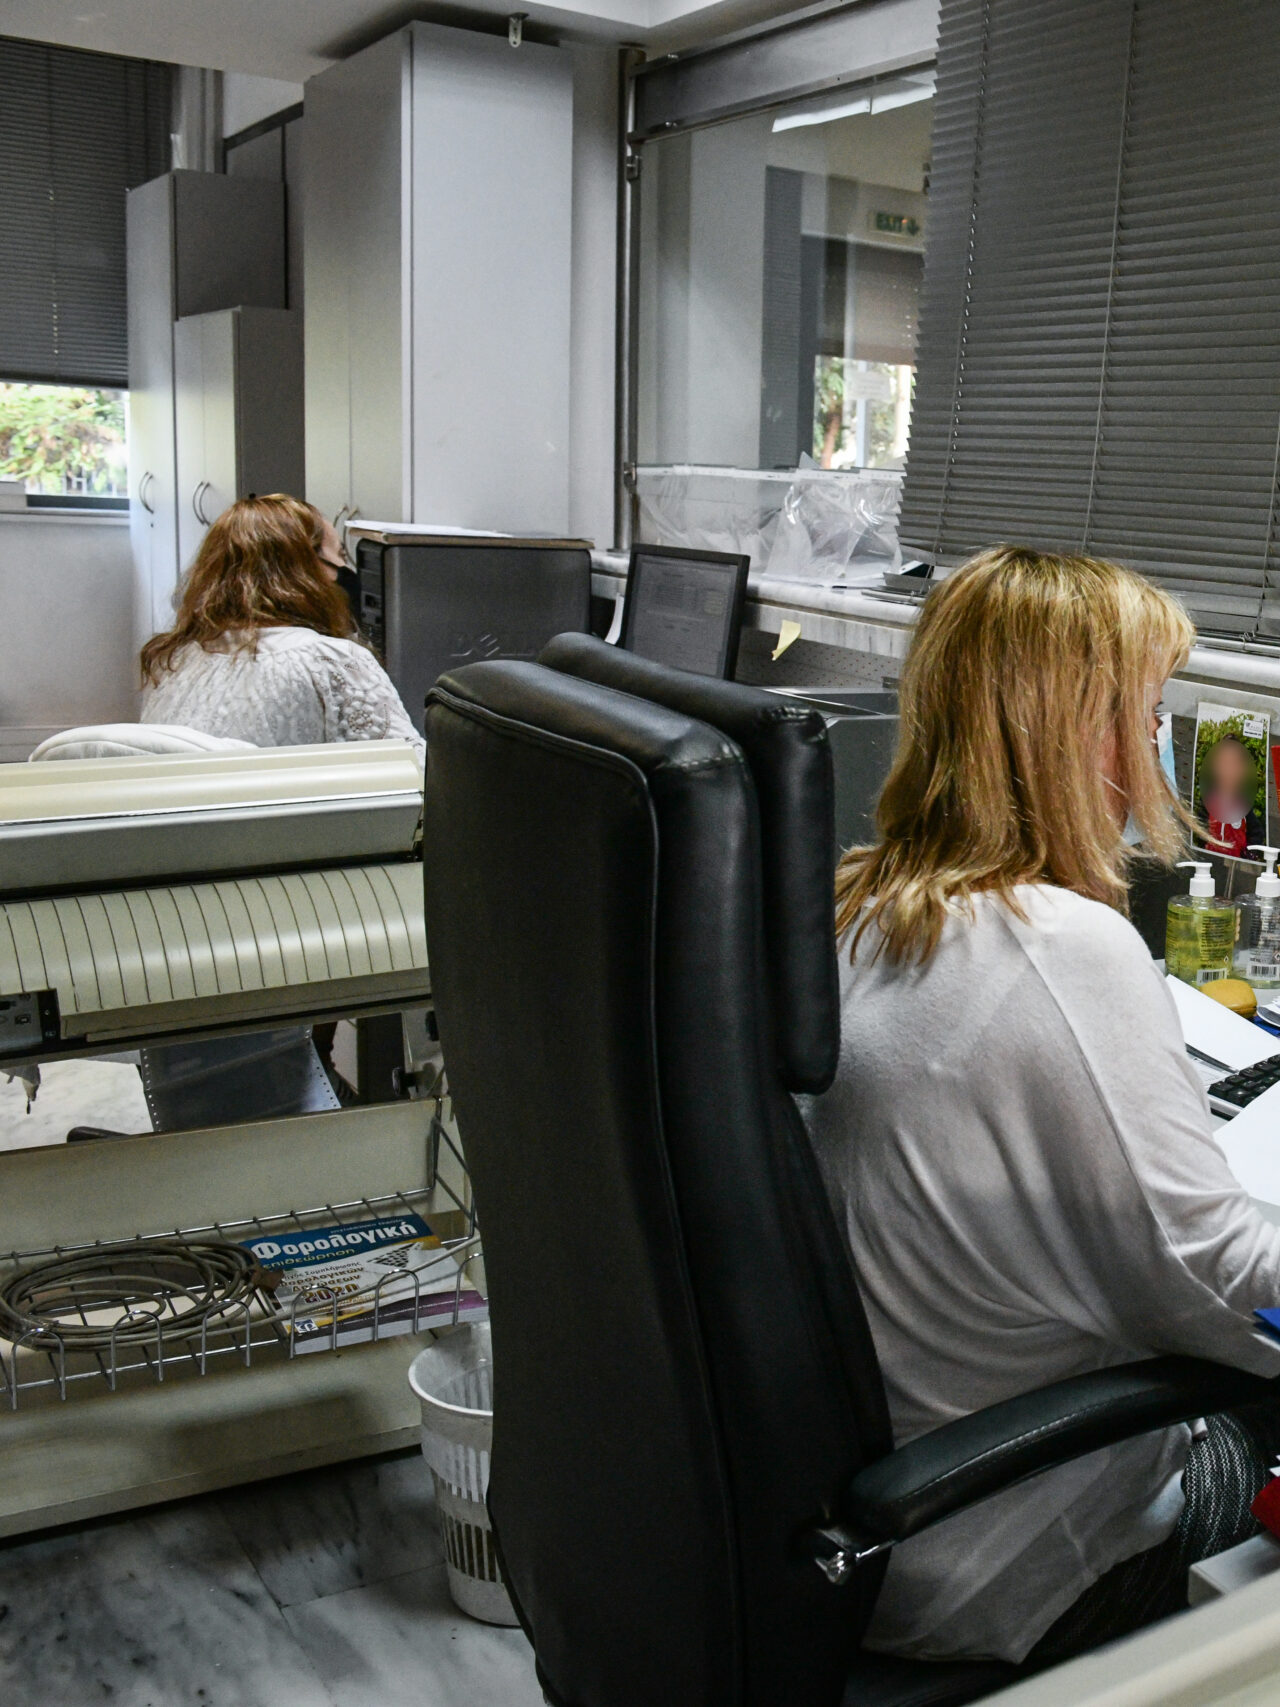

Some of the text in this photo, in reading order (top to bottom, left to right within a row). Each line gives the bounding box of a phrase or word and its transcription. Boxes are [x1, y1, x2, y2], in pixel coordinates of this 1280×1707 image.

[250, 1220, 418, 1260] Φορολογική
[263, 1247, 355, 1271] επιθεώρηση
[302, 1283, 360, 1304] 2020
